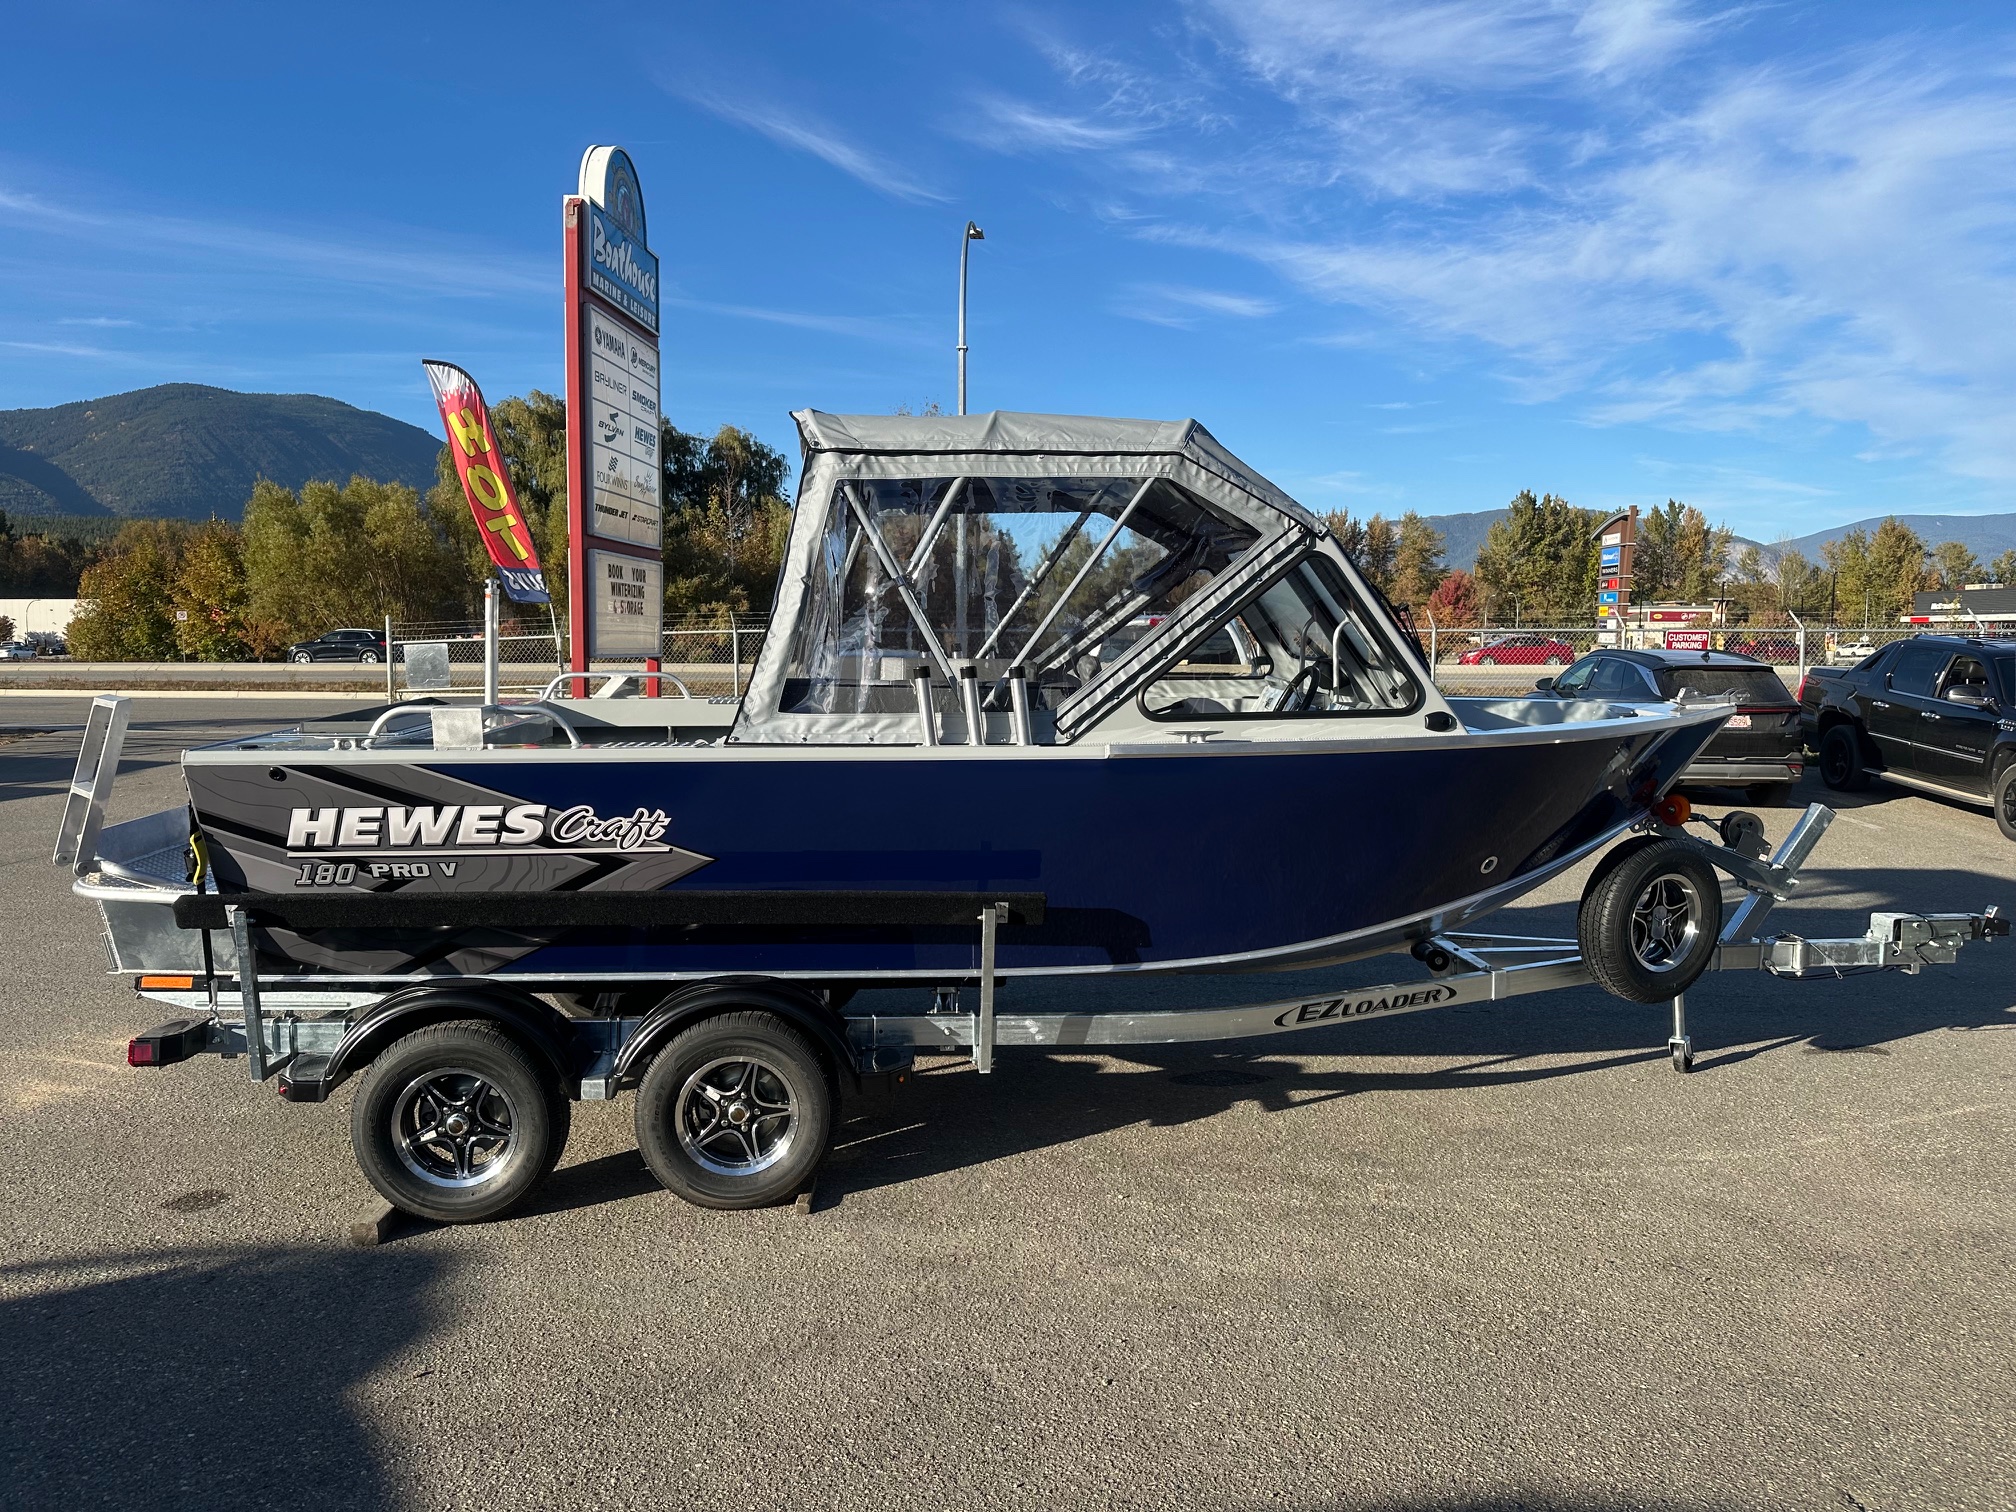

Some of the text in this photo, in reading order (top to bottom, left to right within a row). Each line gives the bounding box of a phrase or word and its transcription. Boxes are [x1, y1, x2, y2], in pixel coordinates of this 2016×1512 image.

[593, 214, 656, 303] Boathouse
[593, 271, 656, 327] MARINE & LEISURE
[602, 330, 626, 359] YAMAHA
[594, 370, 627, 396] BAYLINER
[632, 390, 657, 413] SMOKER
[598, 421, 624, 437] SYLVAN
[635, 426, 656, 447] HEWES
[595, 503, 628, 519] THUNDER JET
[608, 564, 646, 583] BOOK YOUR
[610, 582, 645, 599] WINTERIZING
[620, 600, 643, 615] STORAGE
[1668, 633, 1708, 642] CUSTOMER
[1671, 641, 1703, 649] PARKING
[286, 804, 672, 851] HEWES Craft
[295, 861, 458, 887] 180 PRO V
